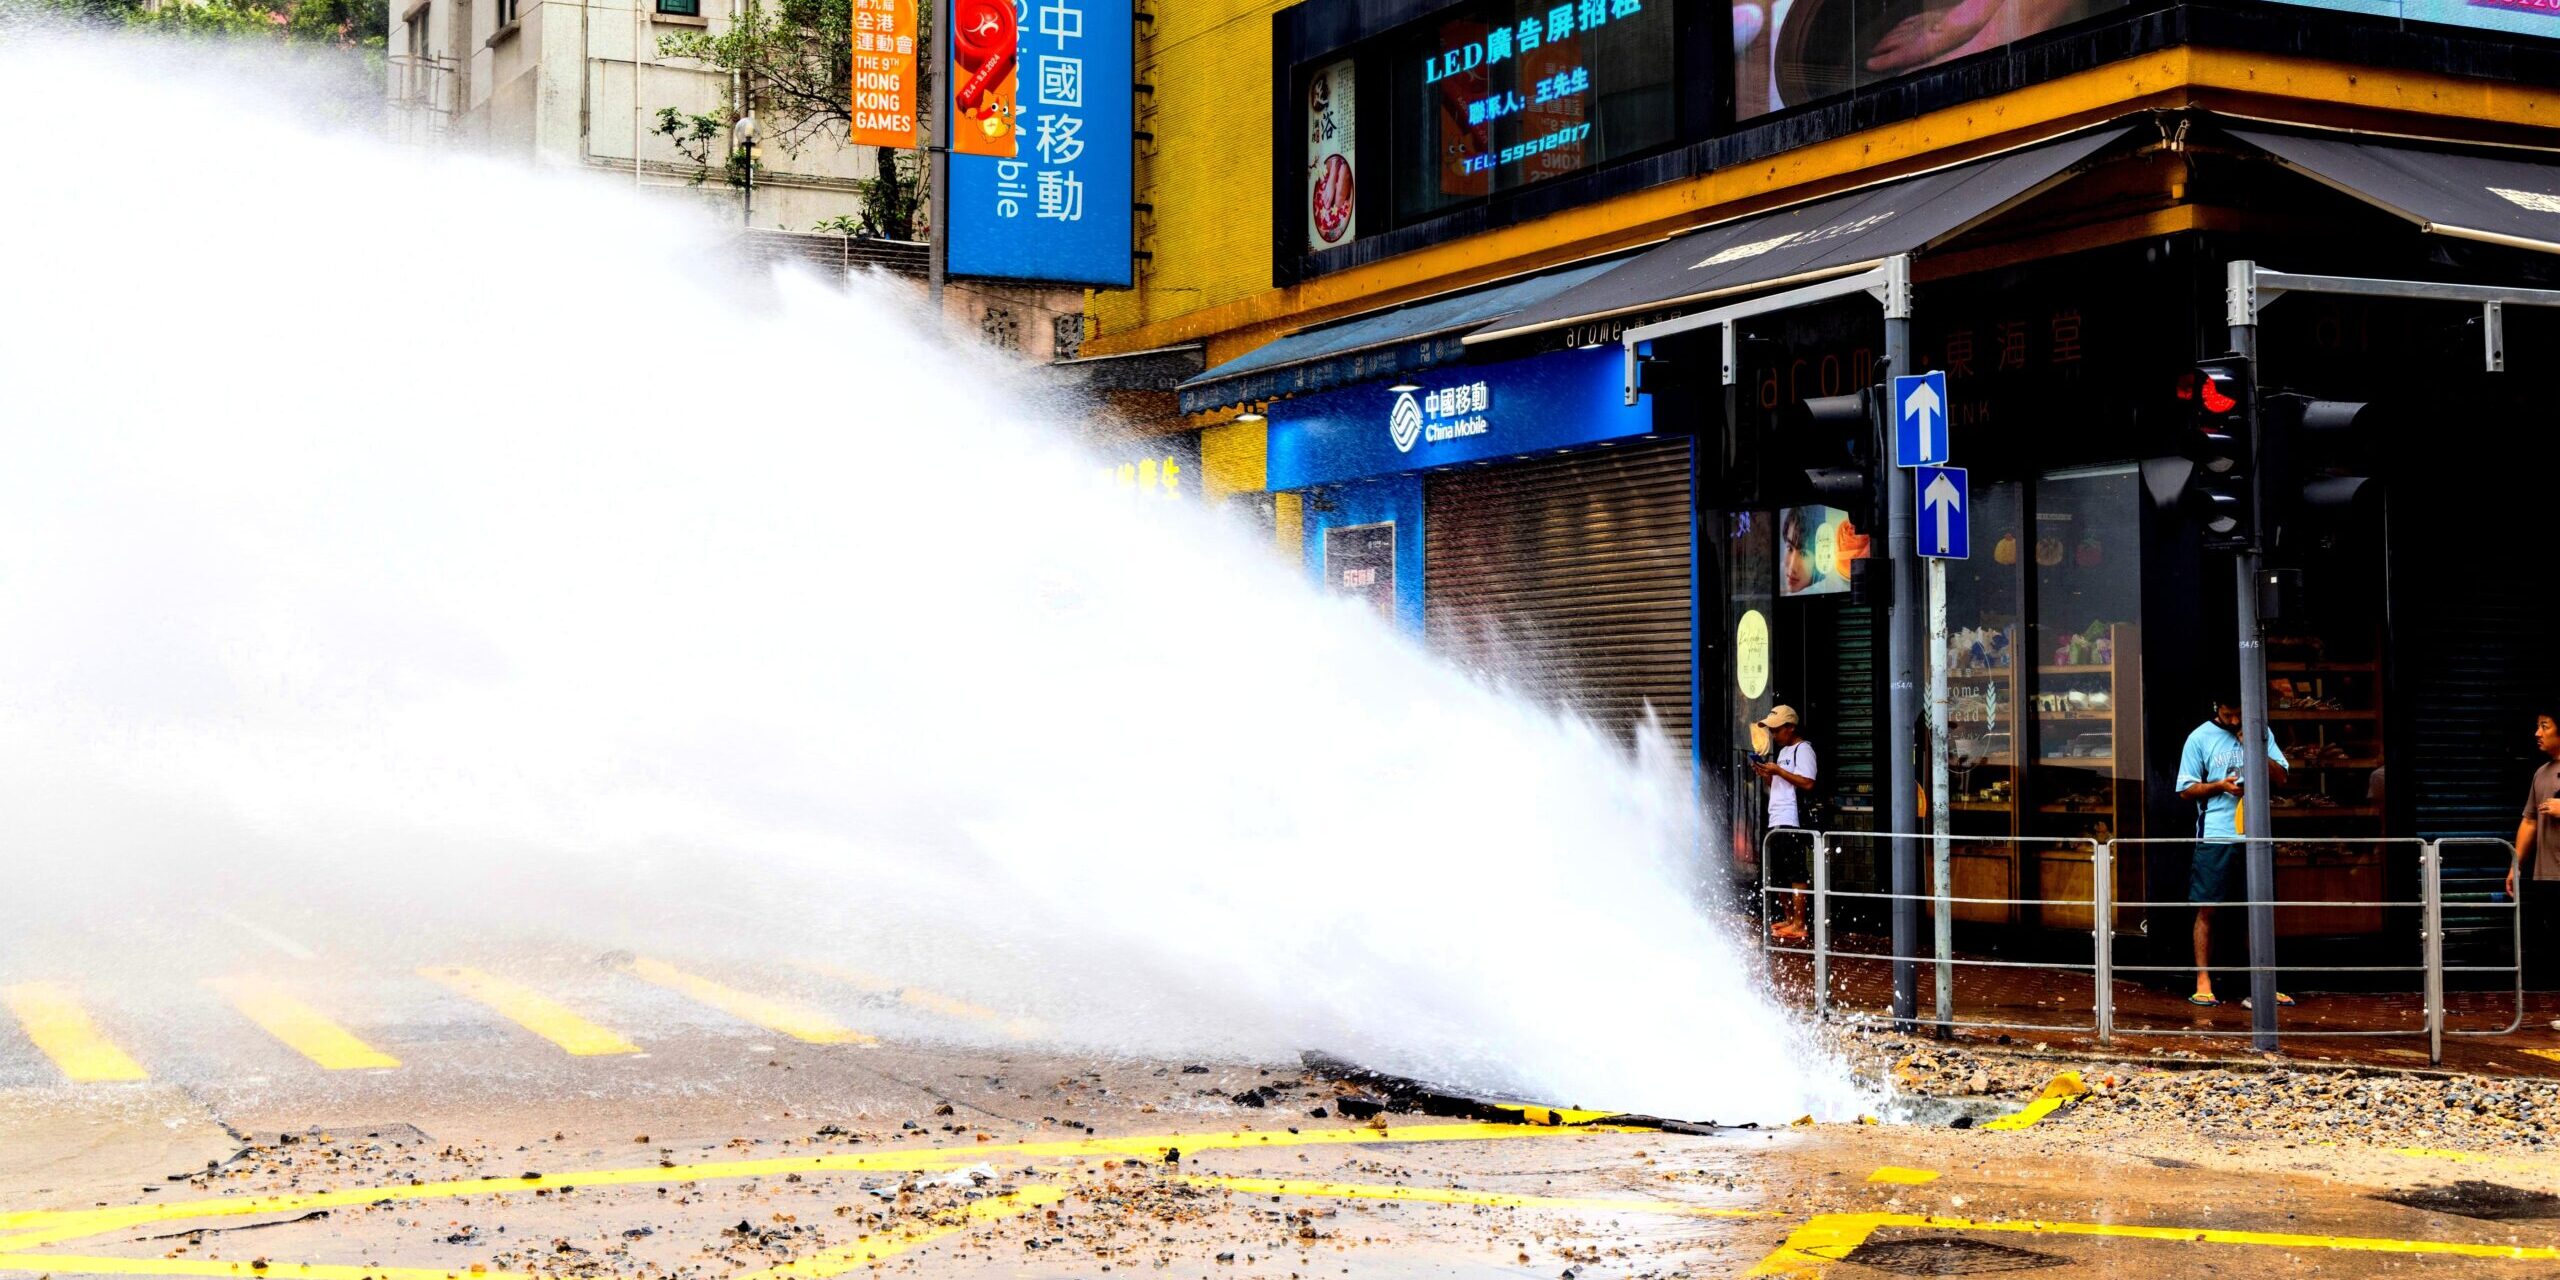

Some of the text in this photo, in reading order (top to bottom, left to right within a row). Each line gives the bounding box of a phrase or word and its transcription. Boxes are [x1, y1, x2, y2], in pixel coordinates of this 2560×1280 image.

[857, 11, 894, 32] 全港
[857, 32, 912, 54] 運動會
[856, 55, 900, 71] THE 9TH
[856, 71, 900, 92] HONG
[856, 91, 900, 112] KONG
[1036, 0, 1084, 222] 中國移動
[856, 111, 911, 133] GAMES
[1566, 320, 1621, 348] arome
[1760, 310, 2082, 409] arom 東海堂
[1425, 380, 1489, 420] 中國移動
[1425, 415, 1488, 443] China Mobile
[1946, 684, 1980, 697] rome
[1948, 706, 1980, 722] read
